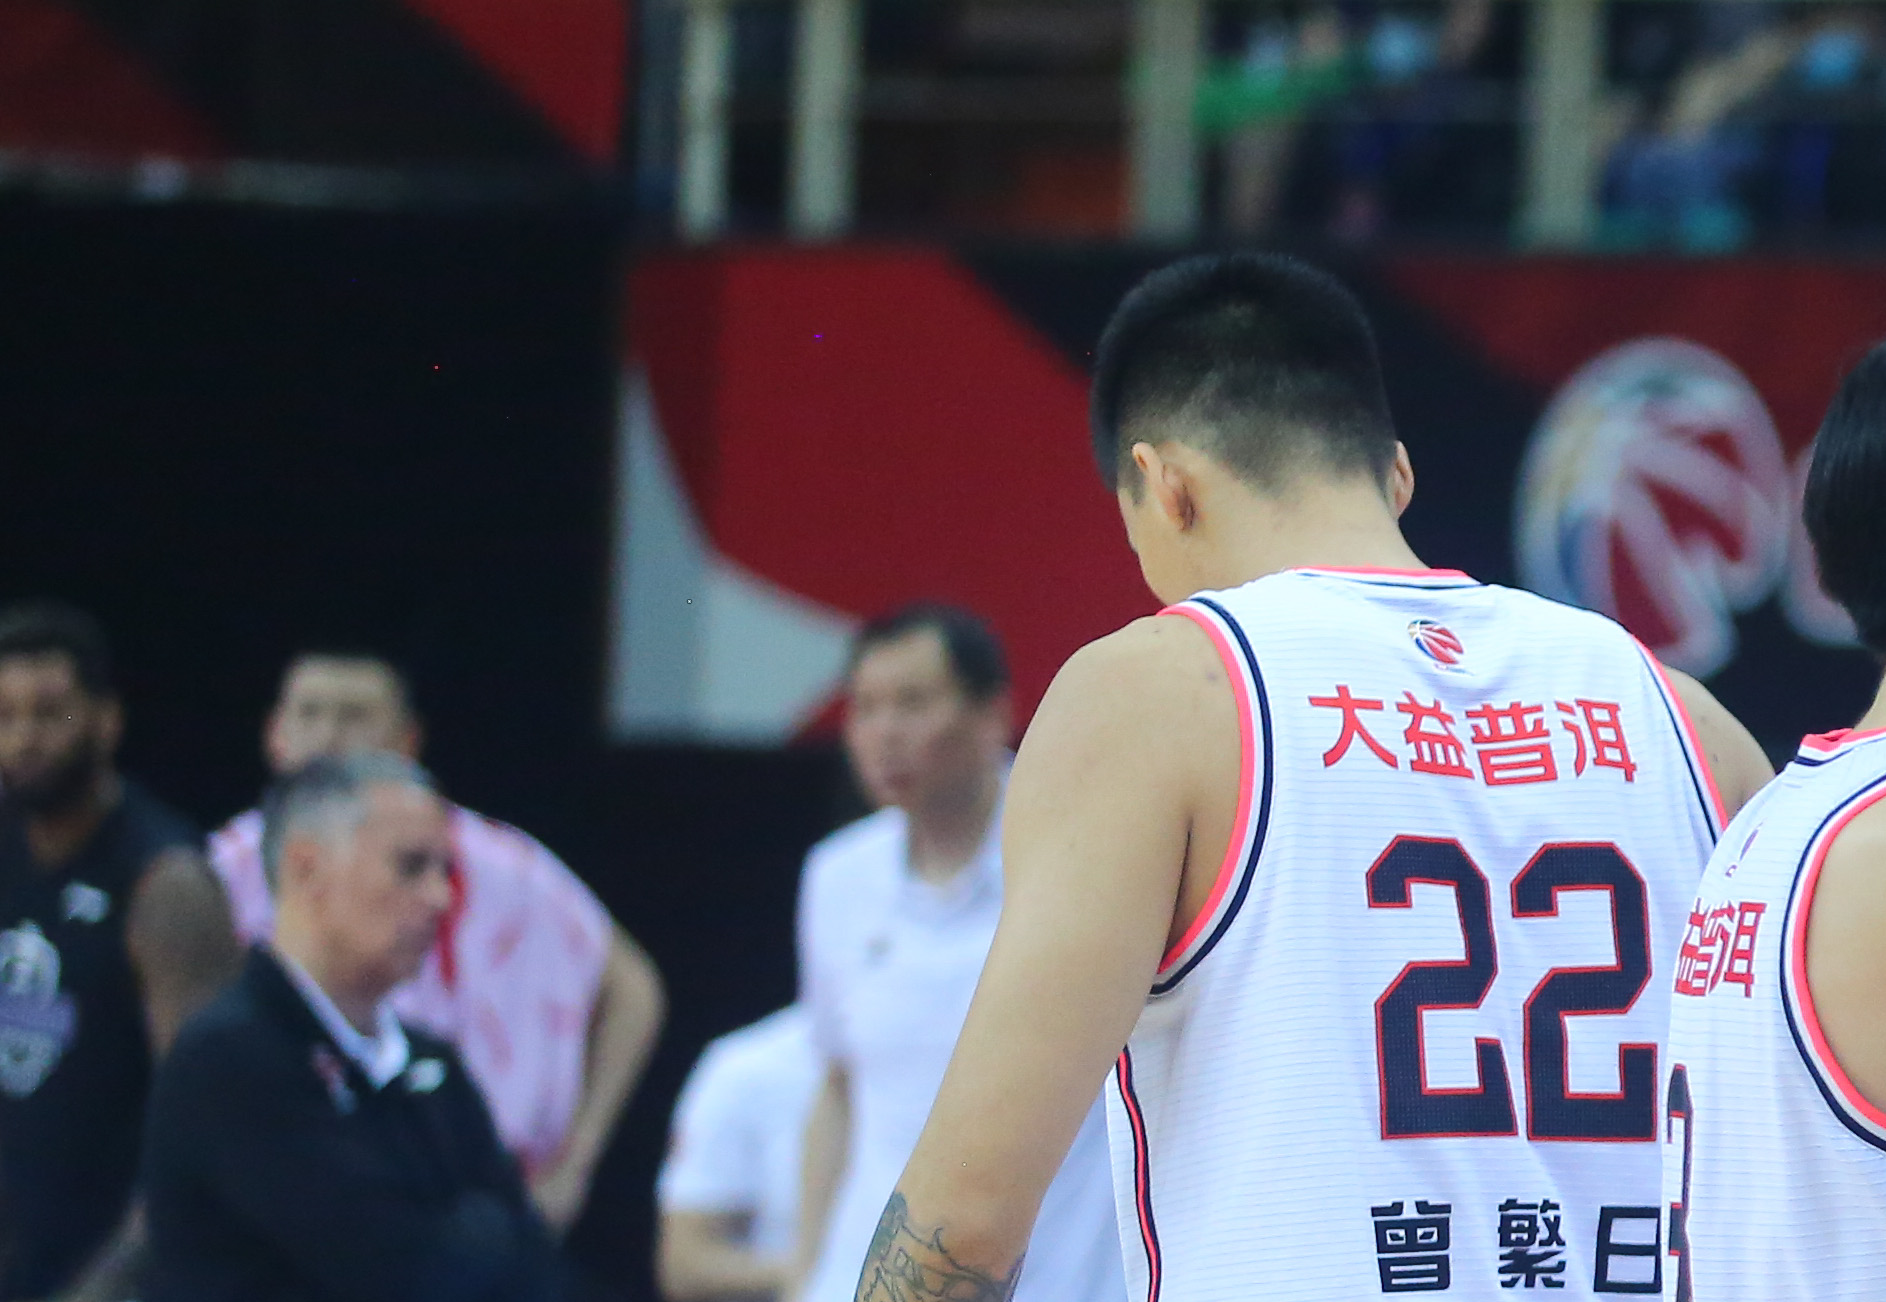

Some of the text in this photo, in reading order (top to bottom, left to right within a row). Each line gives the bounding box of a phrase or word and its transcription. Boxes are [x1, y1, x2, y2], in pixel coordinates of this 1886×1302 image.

[1308, 685, 1638, 787] 大益普洱
[1365, 834, 1659, 1142] 22
